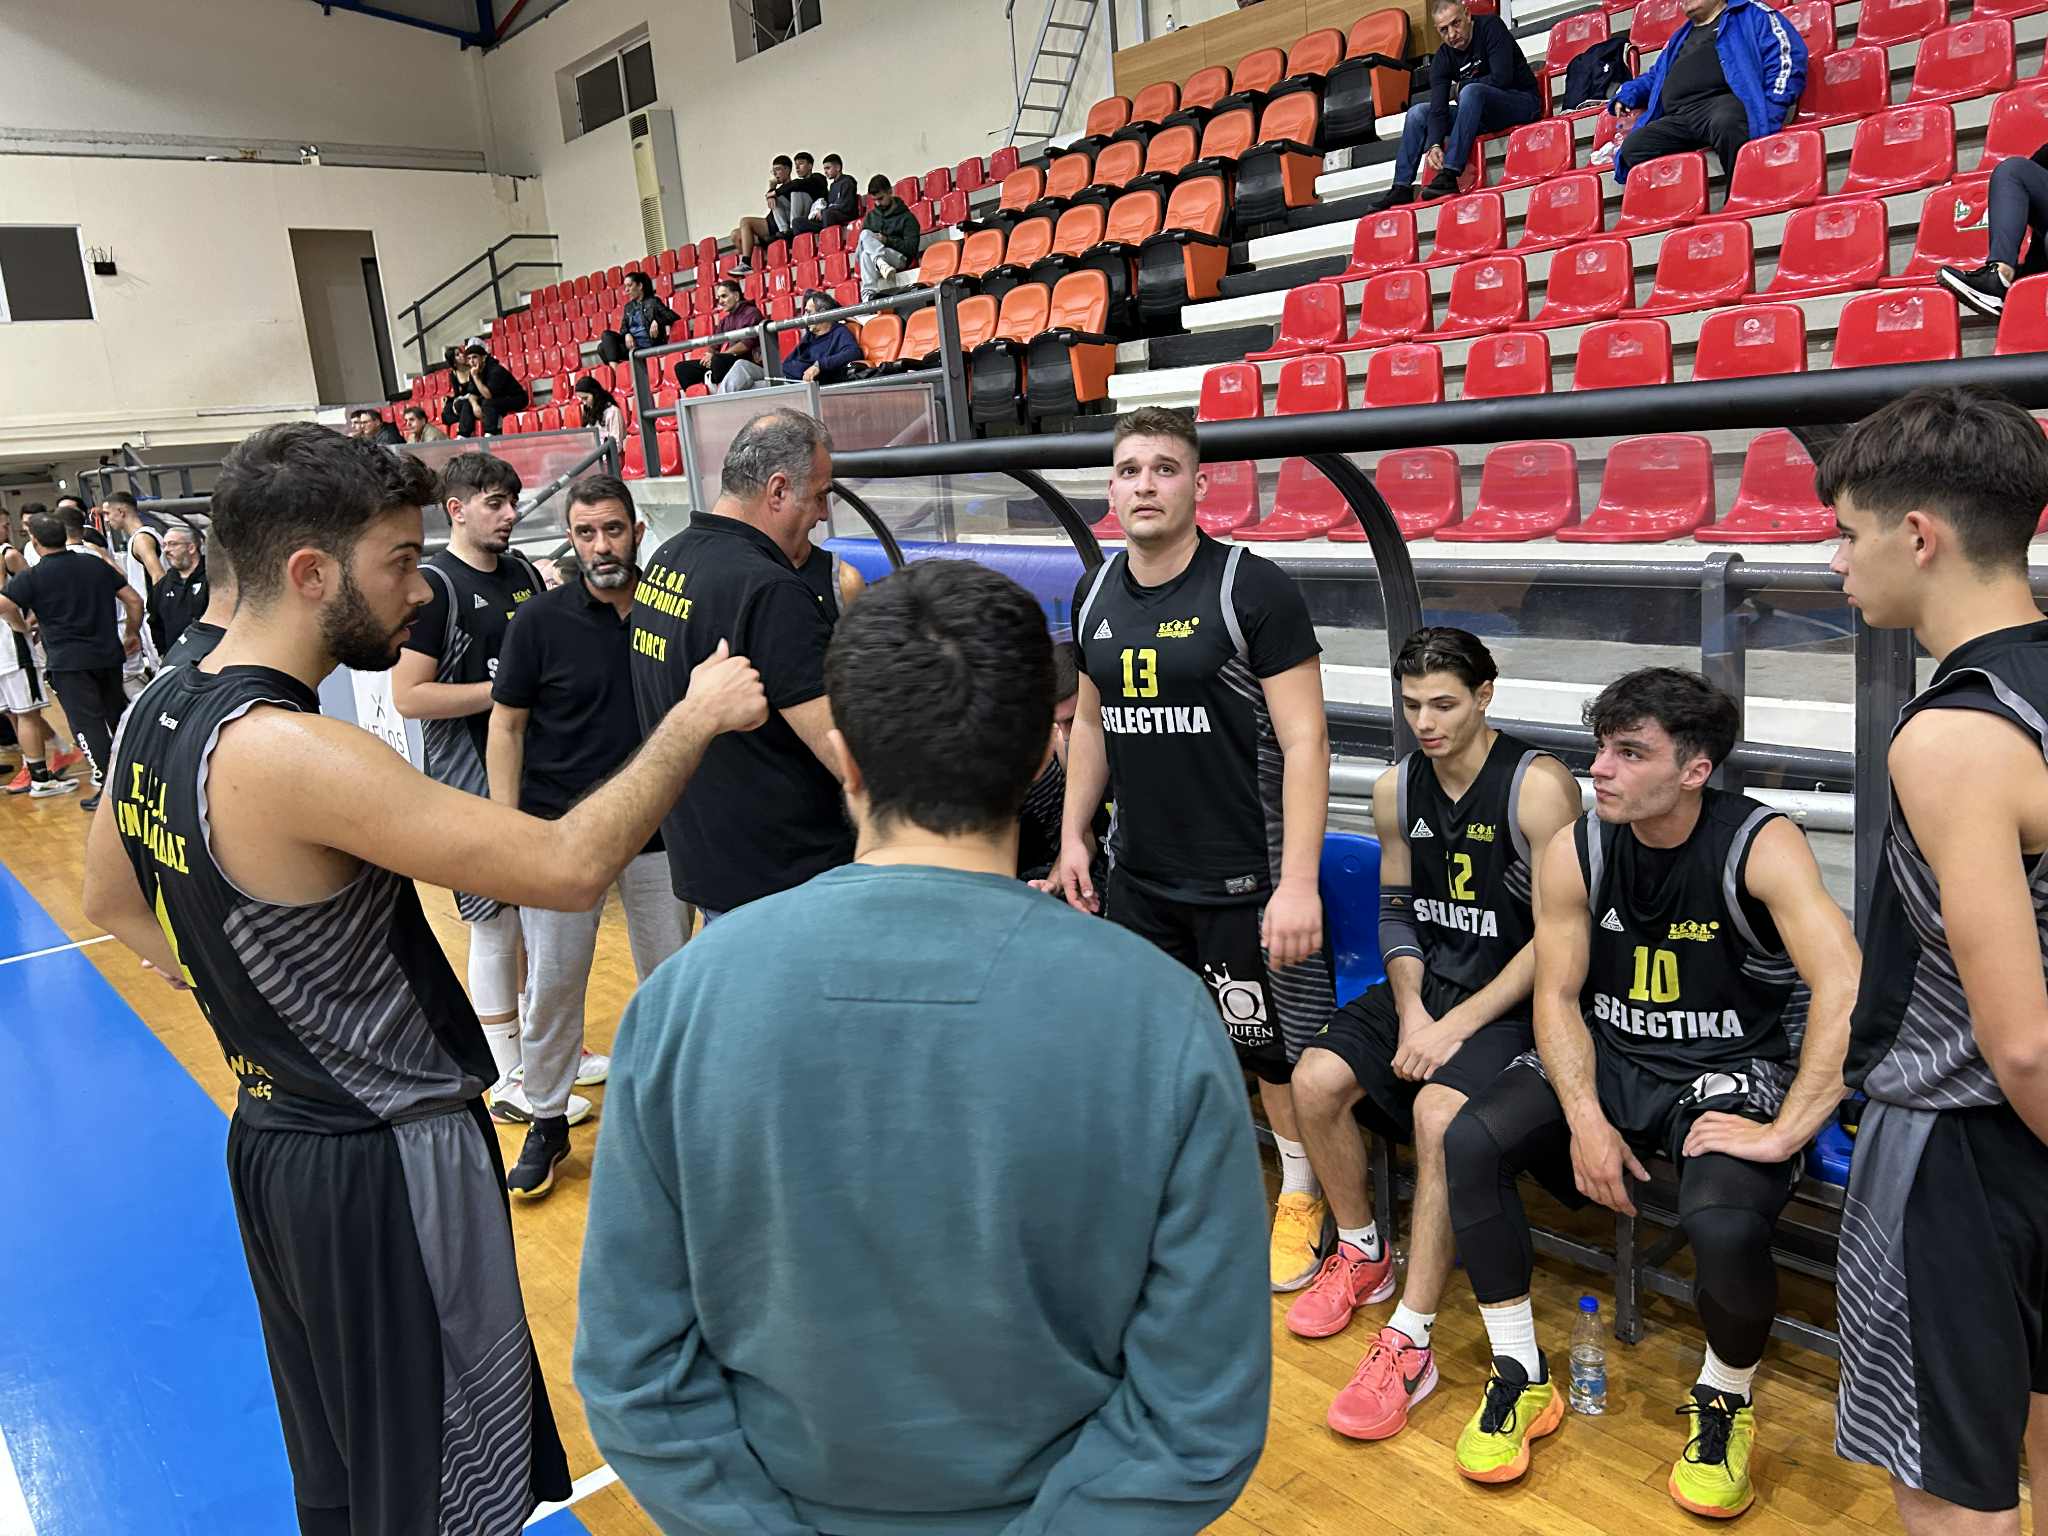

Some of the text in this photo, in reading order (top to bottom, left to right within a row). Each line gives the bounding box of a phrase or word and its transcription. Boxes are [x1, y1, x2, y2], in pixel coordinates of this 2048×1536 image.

[633, 627, 666, 662] COACH
[1120, 648, 1158, 697] 13
[1101, 705, 1211, 734] SELECTIKA
[1628, 946, 1680, 1004] 10
[1594, 993, 1744, 1039] SELECTIKA
